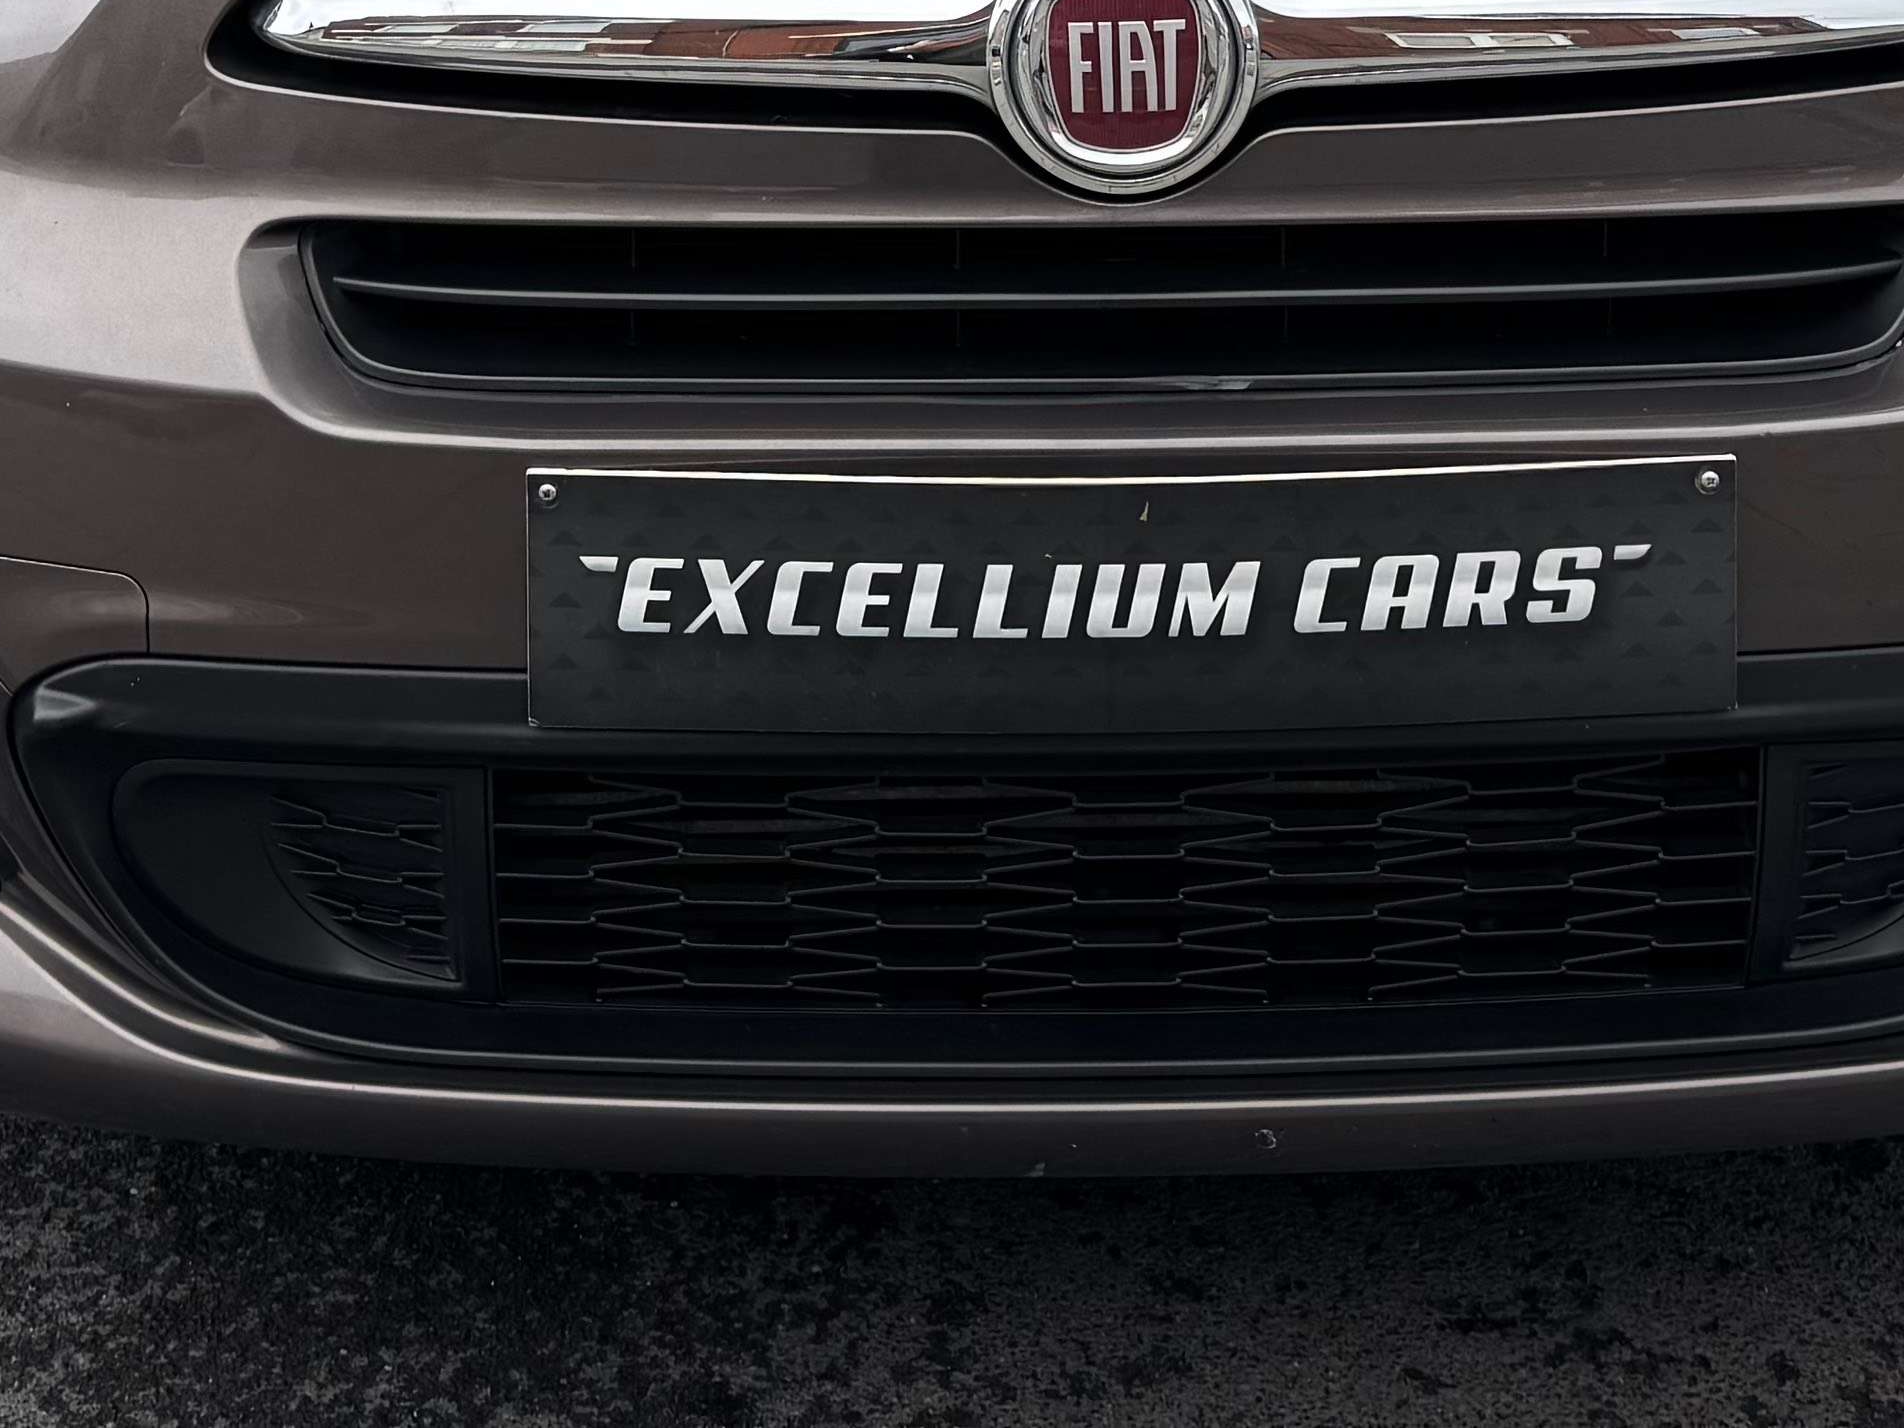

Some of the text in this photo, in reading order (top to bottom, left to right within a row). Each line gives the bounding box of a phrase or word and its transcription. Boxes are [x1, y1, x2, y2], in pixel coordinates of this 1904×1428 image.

[1067, 19, 1186, 113] FIAT
[615, 544, 1603, 642] EXCELLIUM CARS
